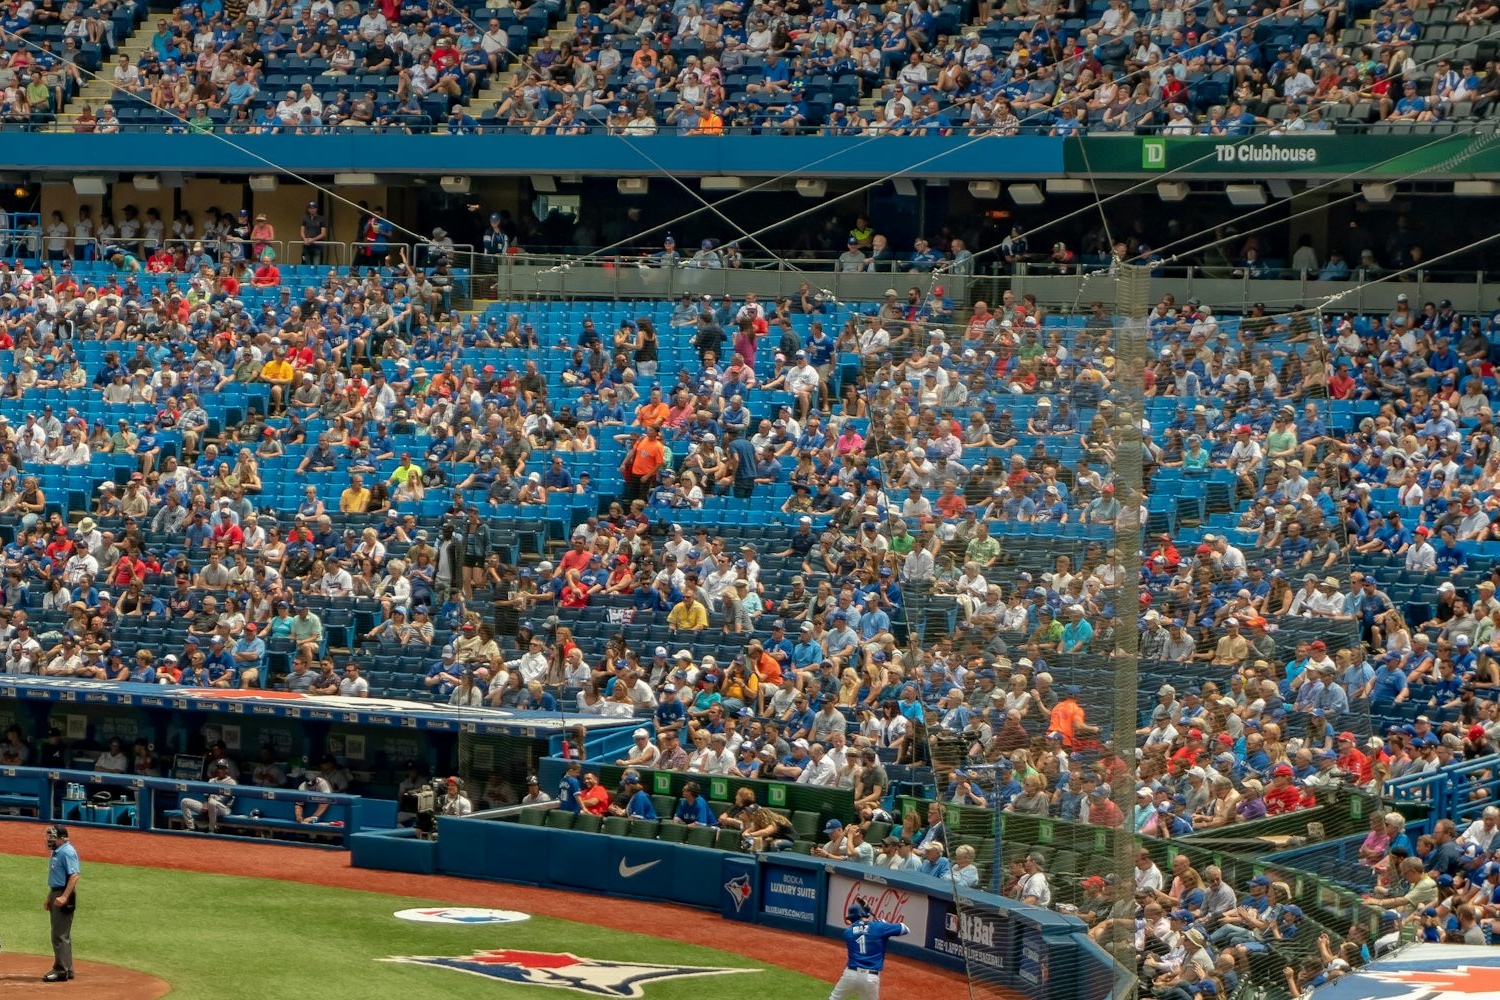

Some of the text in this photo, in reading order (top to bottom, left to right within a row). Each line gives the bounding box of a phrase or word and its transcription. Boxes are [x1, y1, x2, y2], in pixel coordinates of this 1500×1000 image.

[1145, 144, 1163, 162] TD
[1215, 144, 1317, 161] TD Clubhouse
[656, 776, 668, 790] TD
[713, 782, 725, 795] TD
[771, 788, 783, 802] TD
[770, 882, 816, 899] LUXURY SUITE
[973, 916, 995, 948] Bat
[855, 935, 866, 954] 1
